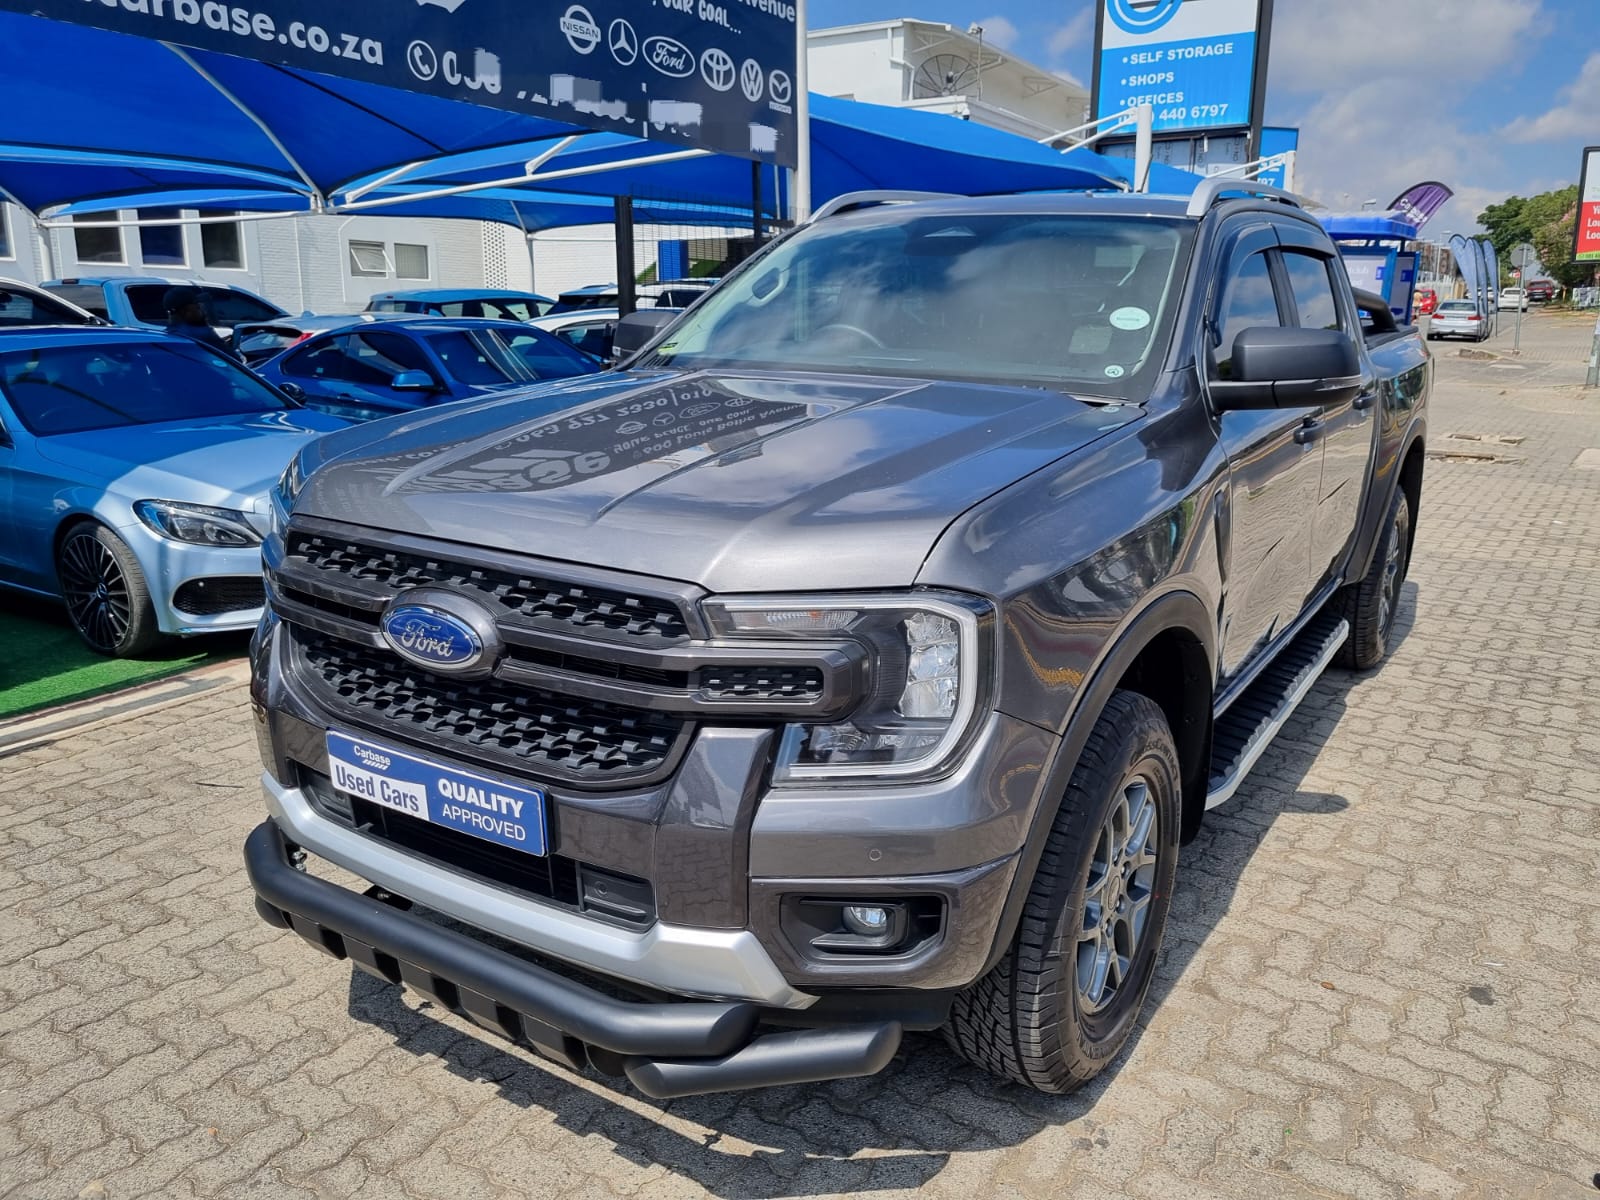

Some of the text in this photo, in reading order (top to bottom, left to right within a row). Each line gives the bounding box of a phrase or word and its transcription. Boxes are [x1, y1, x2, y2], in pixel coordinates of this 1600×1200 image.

[562, 21, 599, 39] NISSAN
[652, 41, 687, 71] Ford
[1130, 42, 1233, 64] SELF STORAGE
[1129, 72, 1174, 86] SHOPS
[1127, 92, 1184, 107] OFFICES
[1159, 107, 1186, 120] 440
[1191, 103, 1229, 118] 6797
[401, 619, 455, 657] Ford
[354, 745, 391, 766] Carbase
[335, 764, 420, 813] Used Cars
[438, 778, 524, 819] QUALITY
[442, 803, 526, 841] APPROVED
